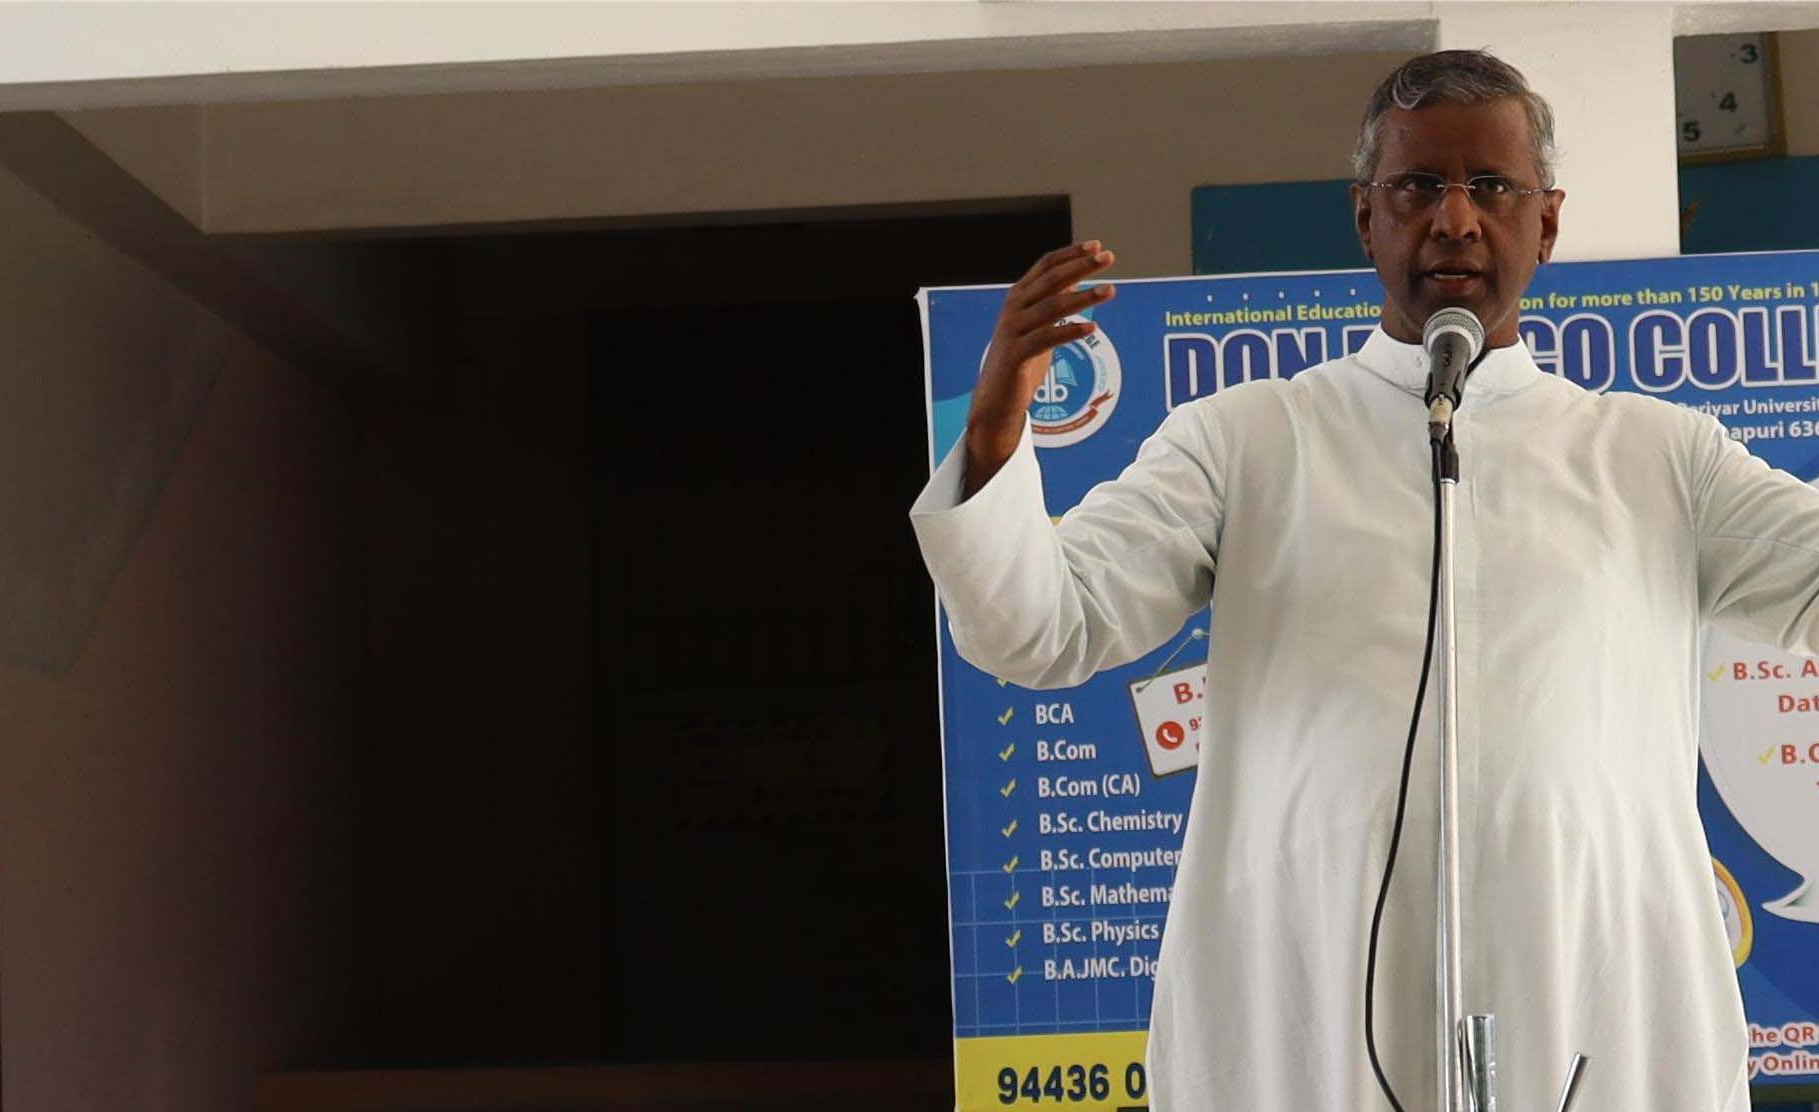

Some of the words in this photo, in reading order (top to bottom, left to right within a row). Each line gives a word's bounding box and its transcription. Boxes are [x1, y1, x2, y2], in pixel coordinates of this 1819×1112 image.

[1741, 44, 1758, 63] 3
[1719, 92, 1738, 112] 4
[1683, 121, 1700, 141] 5
[1165, 305, 1292, 327] International
[1297, 303, 1382, 321] Educatio
[1549, 292, 1577, 310] for
[1582, 294, 1632, 308] more
[1637, 288, 1682, 305] than
[1688, 286, 1723, 302] 150
[1728, 284, 1781, 300] Years
[1787, 282, 1805, 298] in
[1724, 420, 1785, 444] apuri
[1732, 661, 1791, 681] B.Sc.
[1035, 703, 1074, 725] BCA
[1036, 740, 1096, 761] B.Com
[1038, 776, 1097, 797] B.Com
[1102, 774, 1141, 798] (CA)
[1039, 813, 1083, 834] B.Sc.
[1087, 809, 1183, 835] Chemistry
[1040, 850, 1085, 871] B.Sc.
[1088, 848, 1182, 872] Computer
[1042, 886, 1086, 907] B.Sc.
[1043, 922, 1086, 944] B.Sc.
[1091, 920, 1159, 945] Physics
[1044, 957, 1125, 980] B.A.JMC.
[1749, 1027, 1777, 1043] he
[1784, 1026, 1814, 1043] QR
[997, 1064, 1110, 1105] 94436
